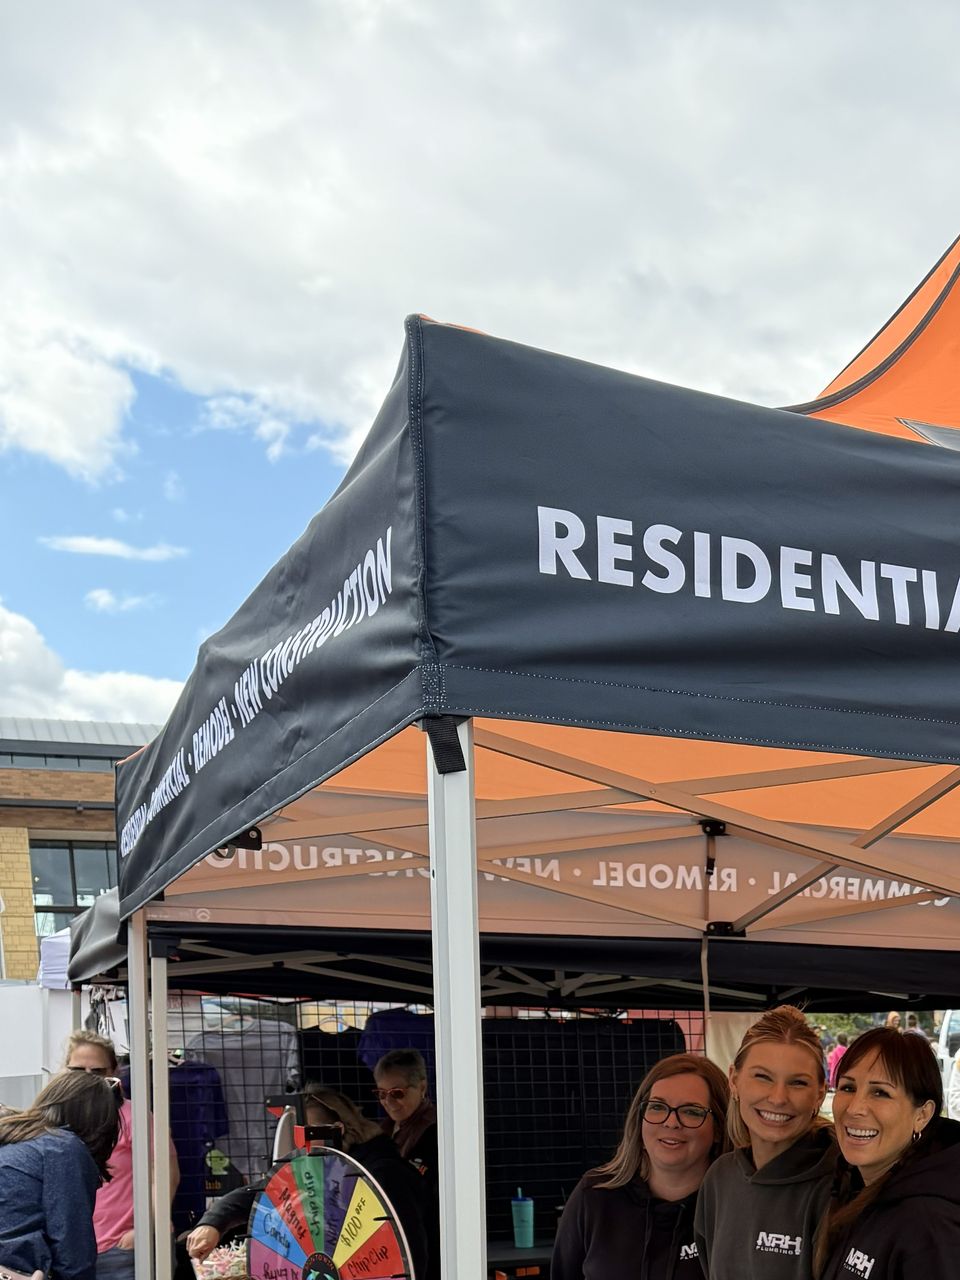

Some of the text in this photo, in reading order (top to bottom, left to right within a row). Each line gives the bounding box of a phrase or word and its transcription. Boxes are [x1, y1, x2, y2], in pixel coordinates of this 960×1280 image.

[192, 696, 235, 774] REMODEL
[234, 657, 263, 728] NEW
[260, 526, 393, 699] CONSTRUCTION
[340, 1214, 363, 1247] $100
[756, 1231, 802, 1256] NRH
[845, 1247, 876, 1280] NRH
